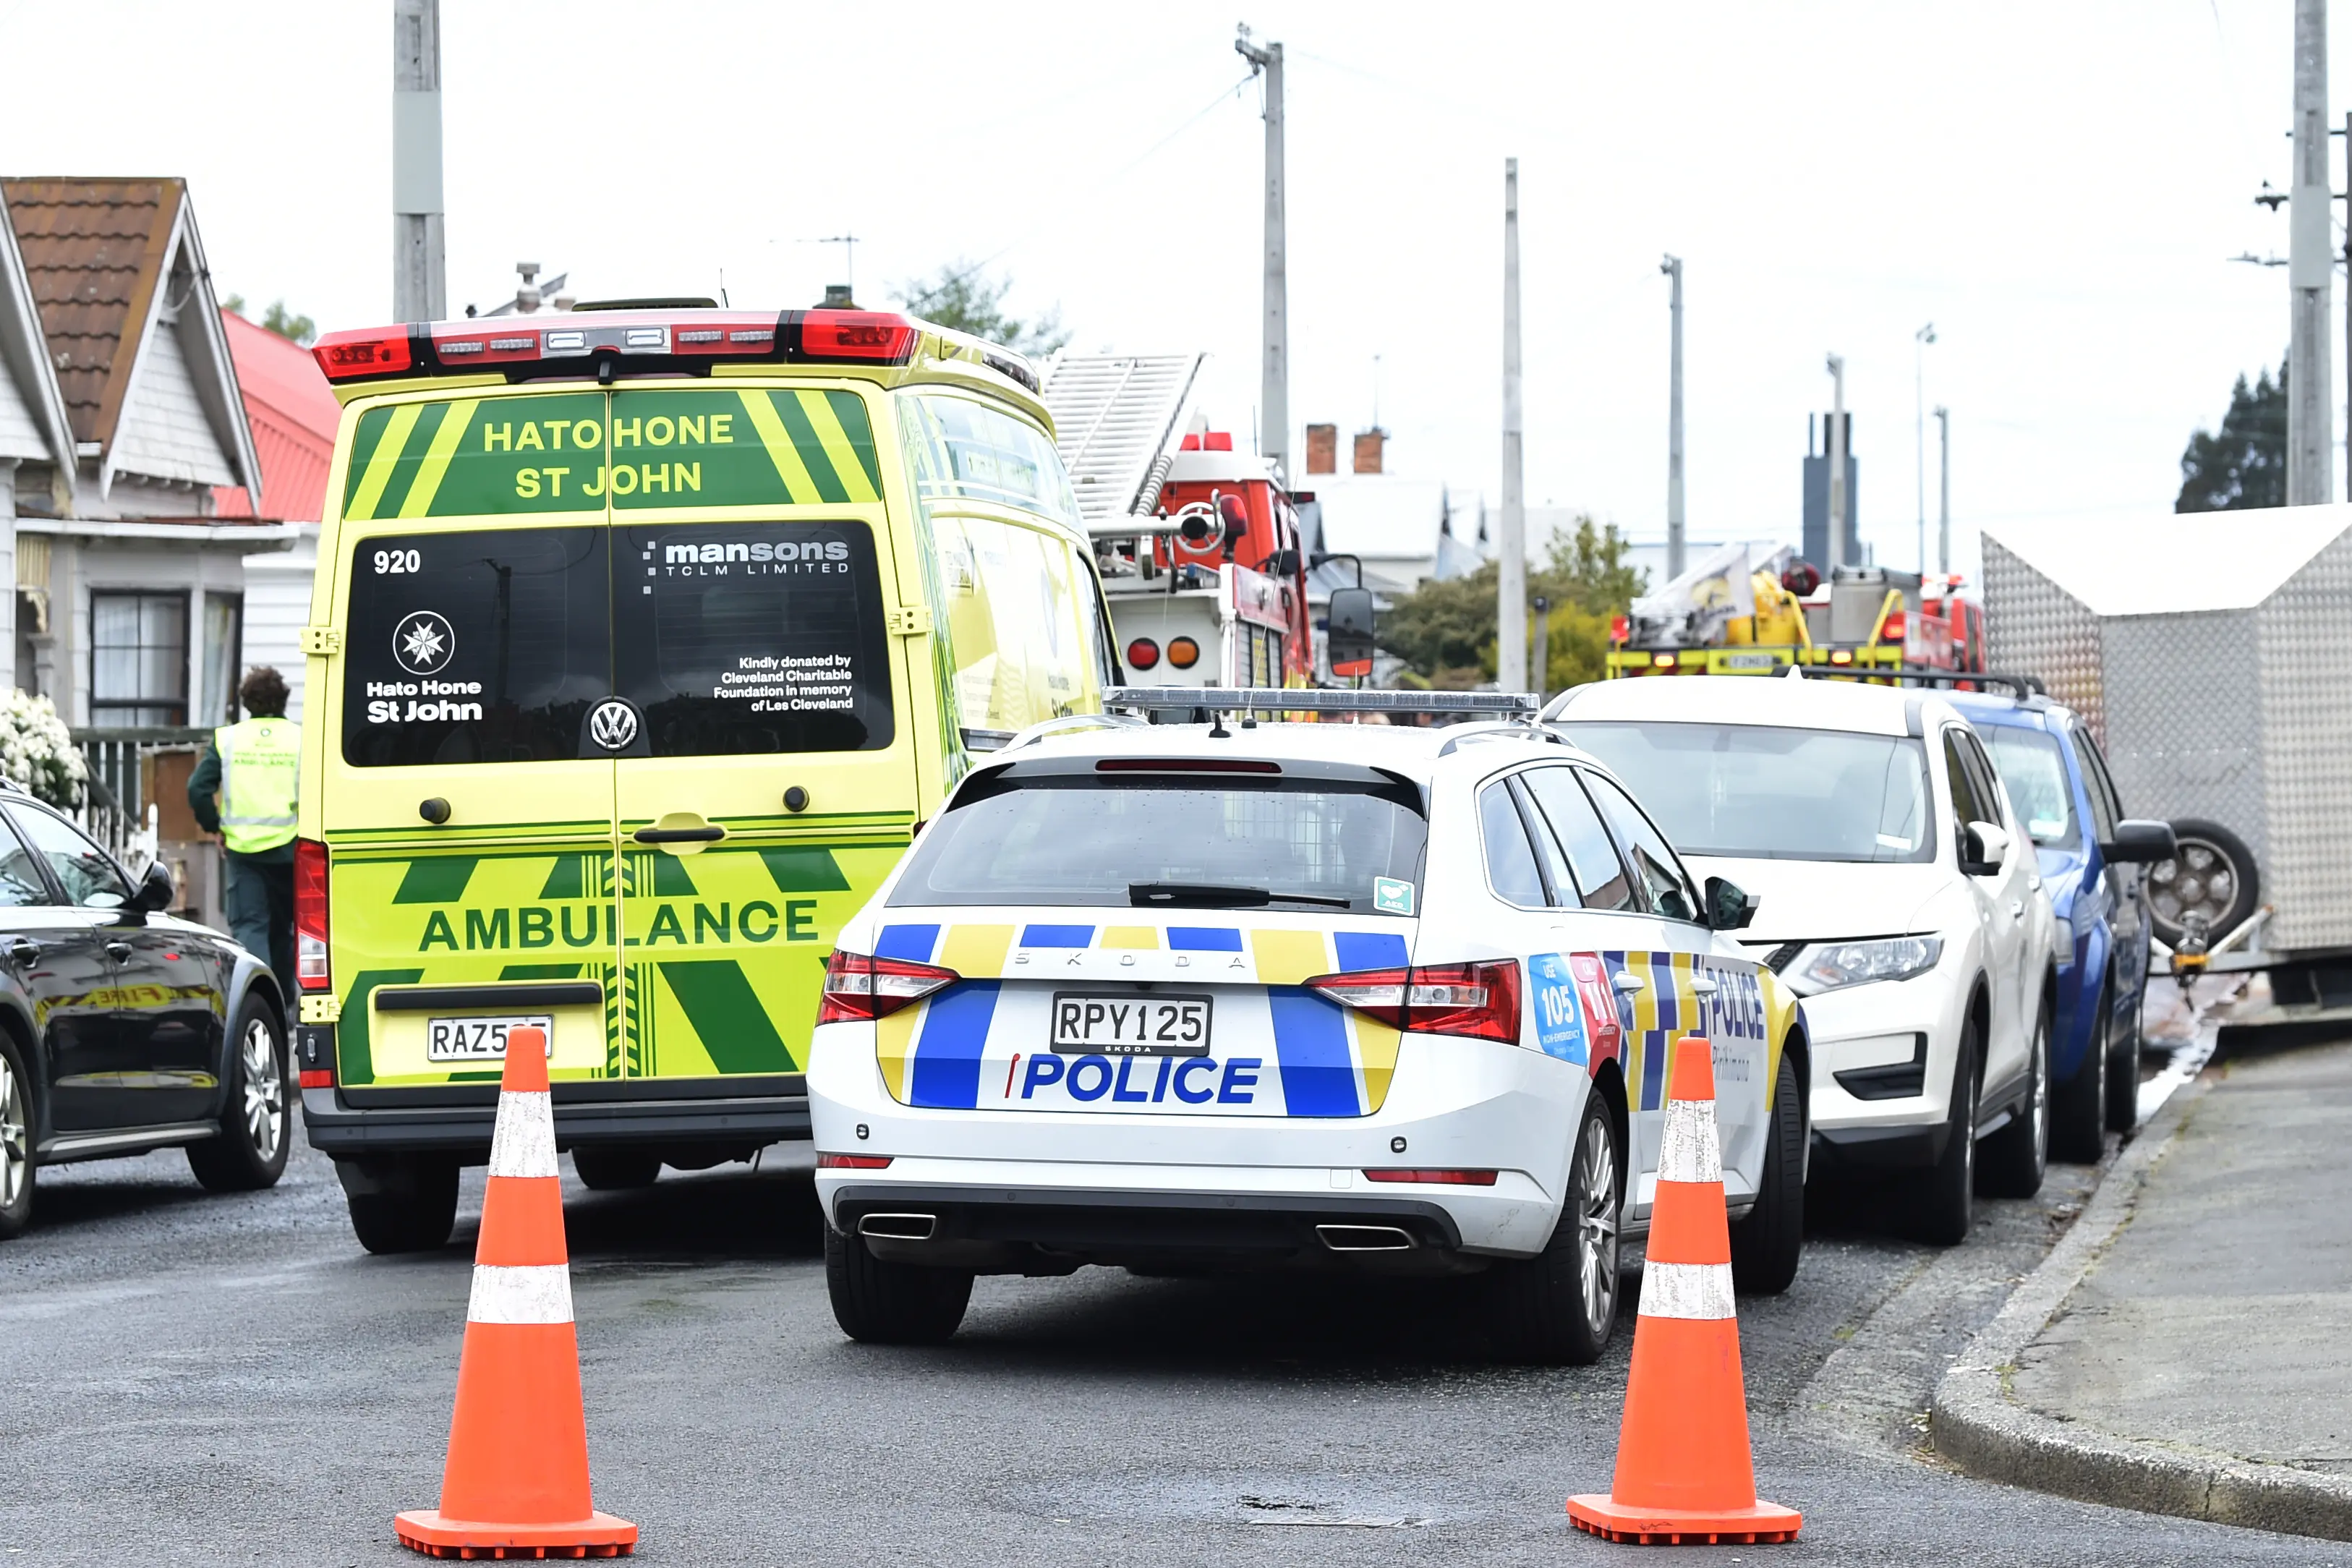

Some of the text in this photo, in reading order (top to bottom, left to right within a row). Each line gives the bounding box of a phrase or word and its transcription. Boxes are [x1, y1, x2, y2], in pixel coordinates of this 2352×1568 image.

[485, 414, 733, 451] HATO HONE
[516, 462, 701, 498] ST JOHN
[374, 549, 421, 574] 920
[665, 542, 849, 563] mansons
[665, 563, 848, 576] TCLM LIMITED
[721, 669, 852, 683] Cleveland Charitable
[739, 654, 851, 670] Kindly donated by
[367, 680, 482, 696] Hato Hone
[714, 685, 852, 699] Foundation in memory
[367, 699, 482, 723] St John
[751, 697, 853, 712] of Les Cleveland
[417, 899, 819, 952] AMBULANCE
[1541, 985, 1575, 1027] 105
[1585, 982, 1614, 1020] 111
[1706, 968, 1764, 1040] POLICE
[1060, 1004, 1201, 1041] RPY125
[433, 1023, 547, 1054] RAZ5
[1021, 1054, 1263, 1104] POLICE
